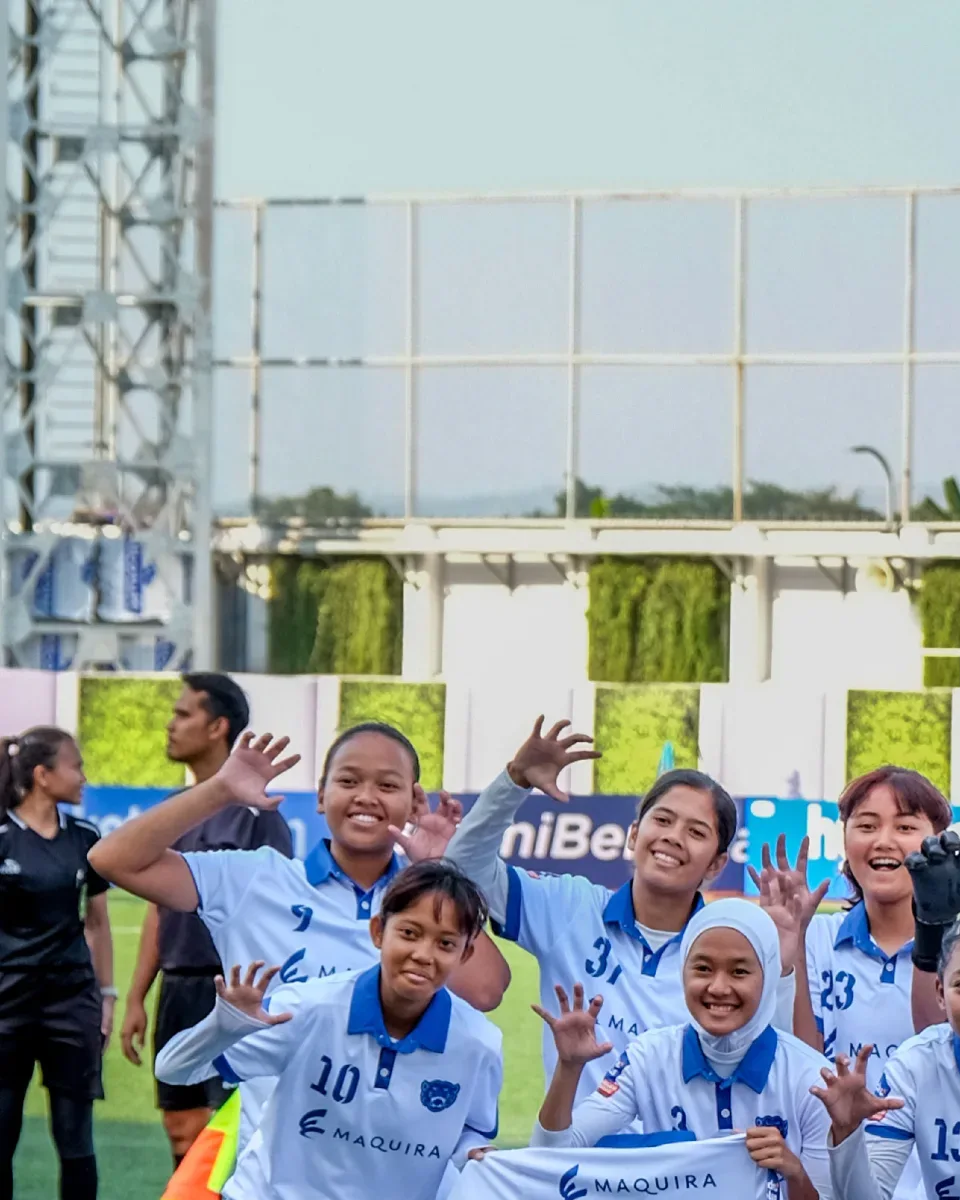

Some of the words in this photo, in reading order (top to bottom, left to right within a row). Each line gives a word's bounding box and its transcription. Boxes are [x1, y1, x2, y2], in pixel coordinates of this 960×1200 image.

[820, 970, 856, 1011] 23
[310, 1055, 360, 1104] 10
[333, 1128, 440, 1159] MAQUIRA
[594, 1173, 717, 1195] MAQUIRA
